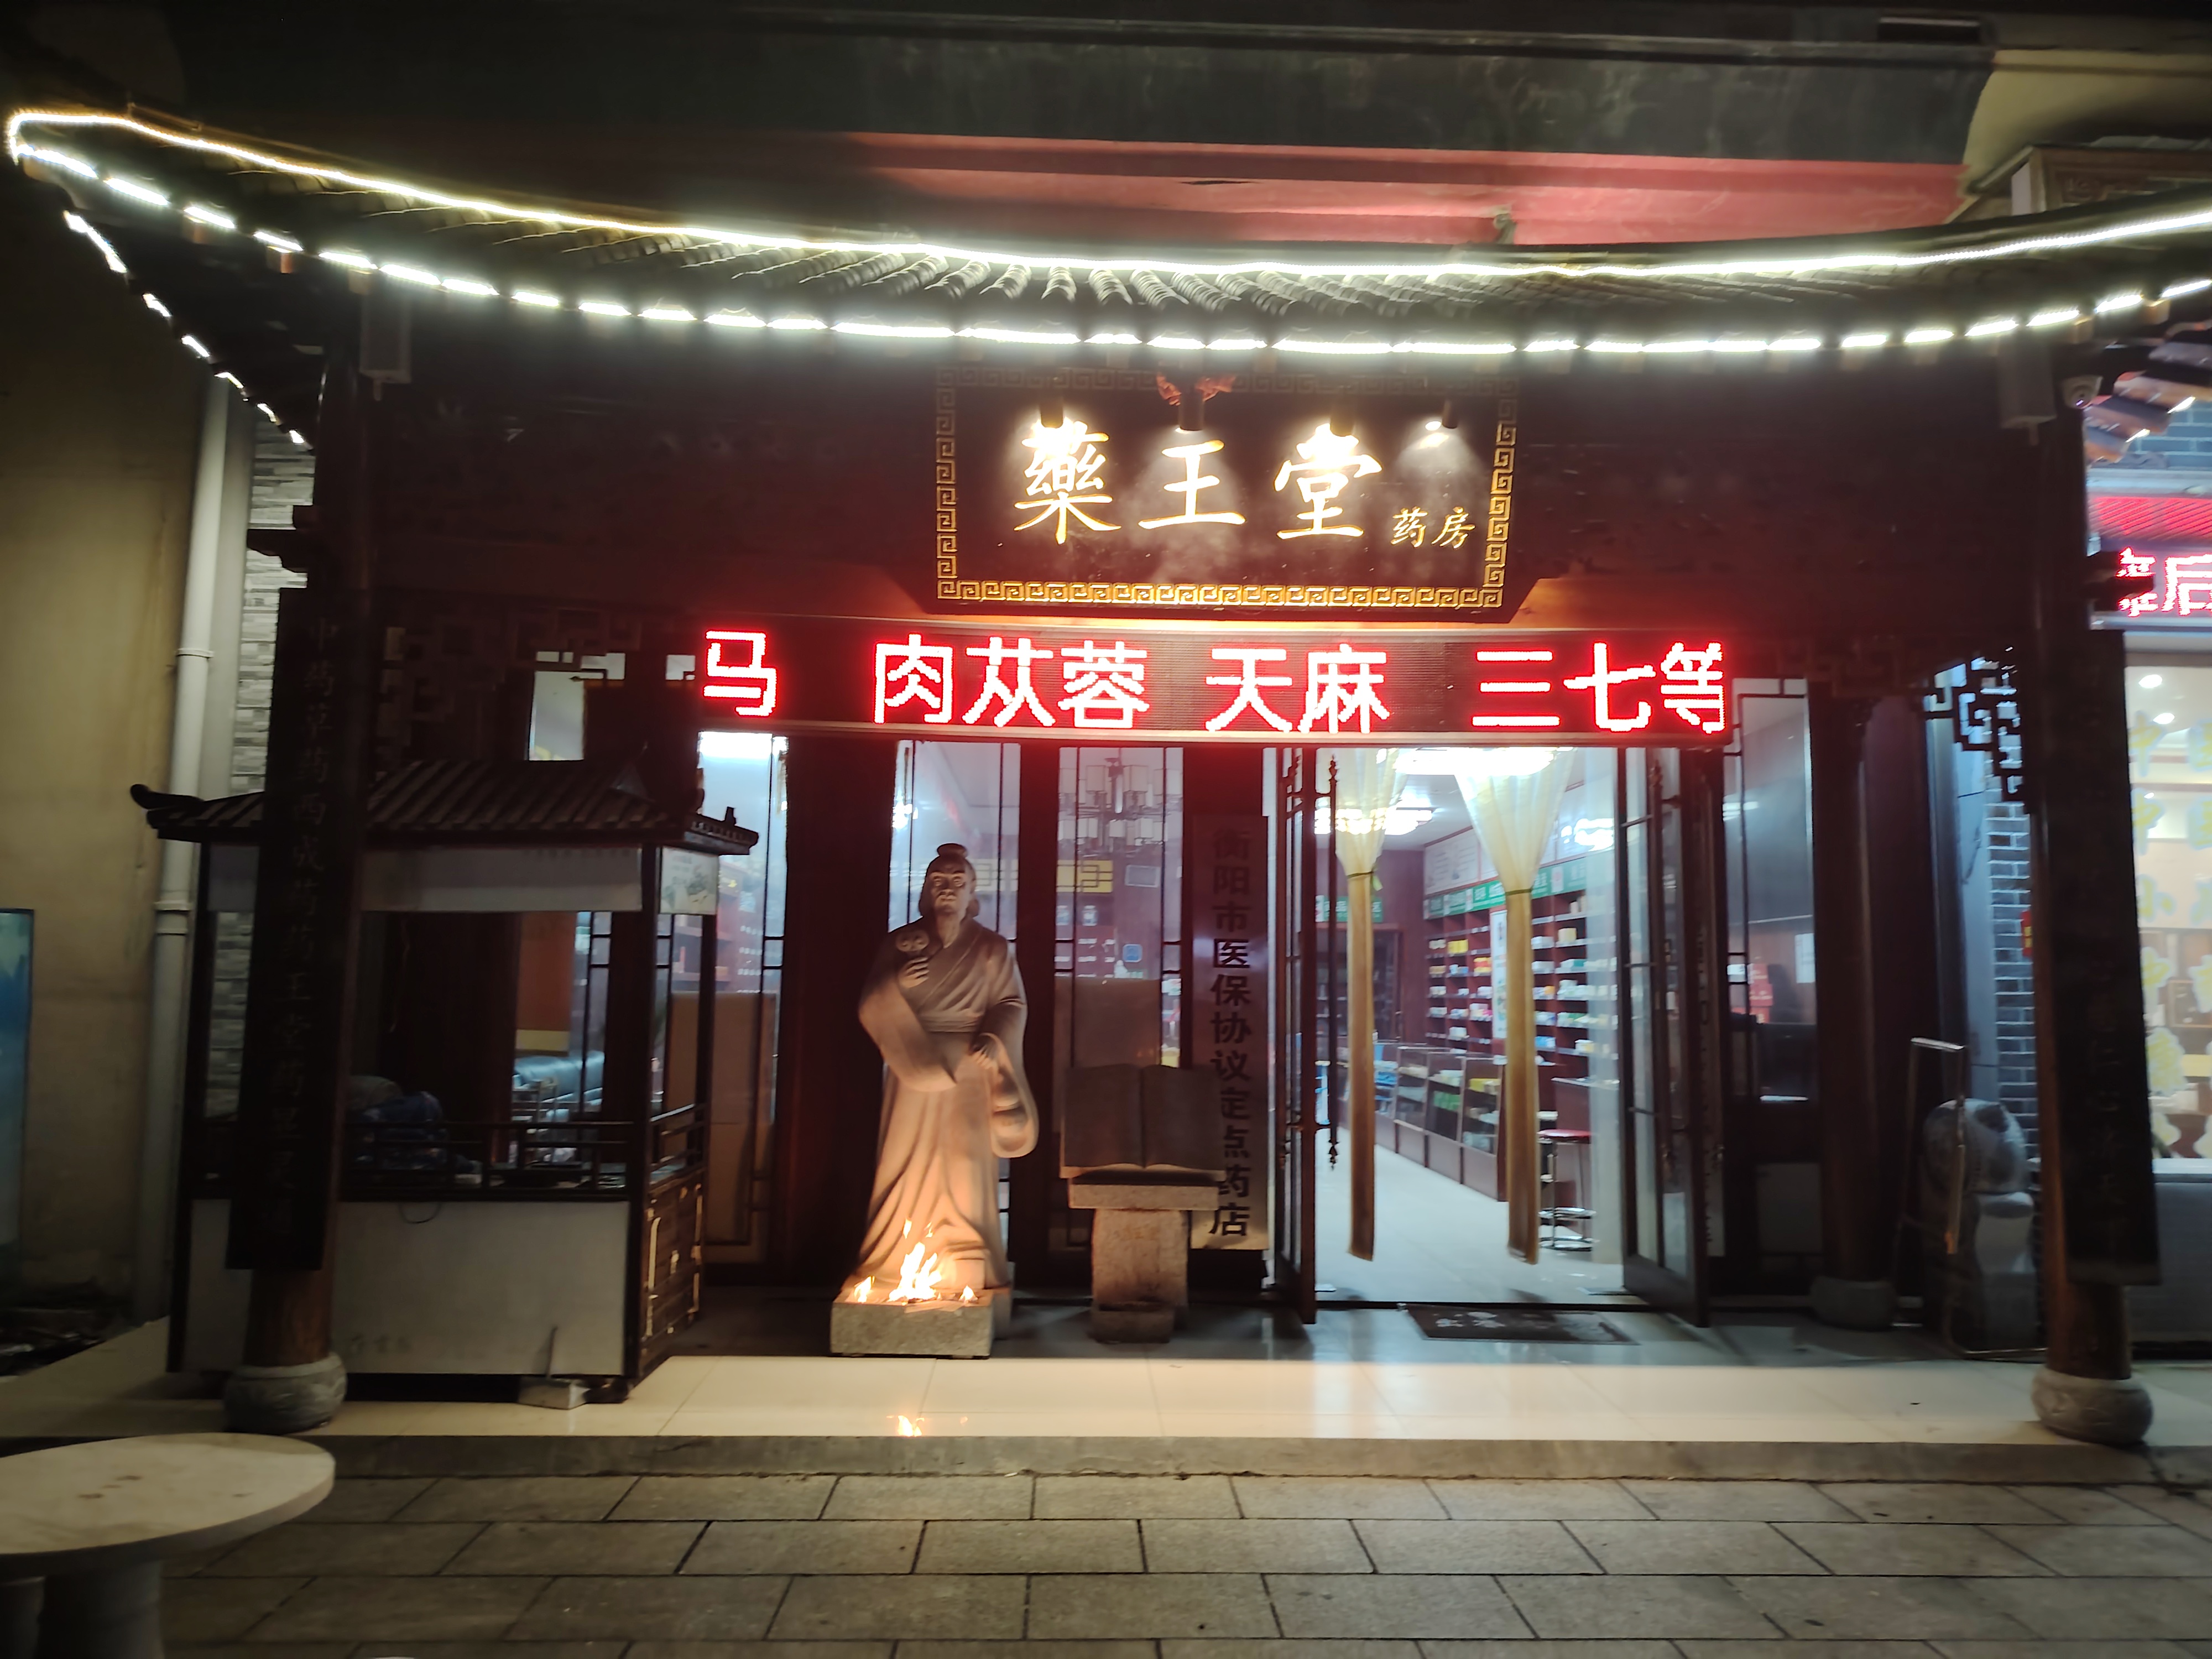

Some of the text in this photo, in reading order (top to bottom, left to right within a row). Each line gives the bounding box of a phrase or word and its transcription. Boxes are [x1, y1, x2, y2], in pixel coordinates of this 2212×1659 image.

[1014, 418, 1383, 544] 藥王堂
[1390, 506, 1475, 549] 药房
[704, 630, 1725, 734] 马 肉苁蓉 天麻 三七等
[1209, 829, 1251, 1237] 衡阳市医保协议定点药店
